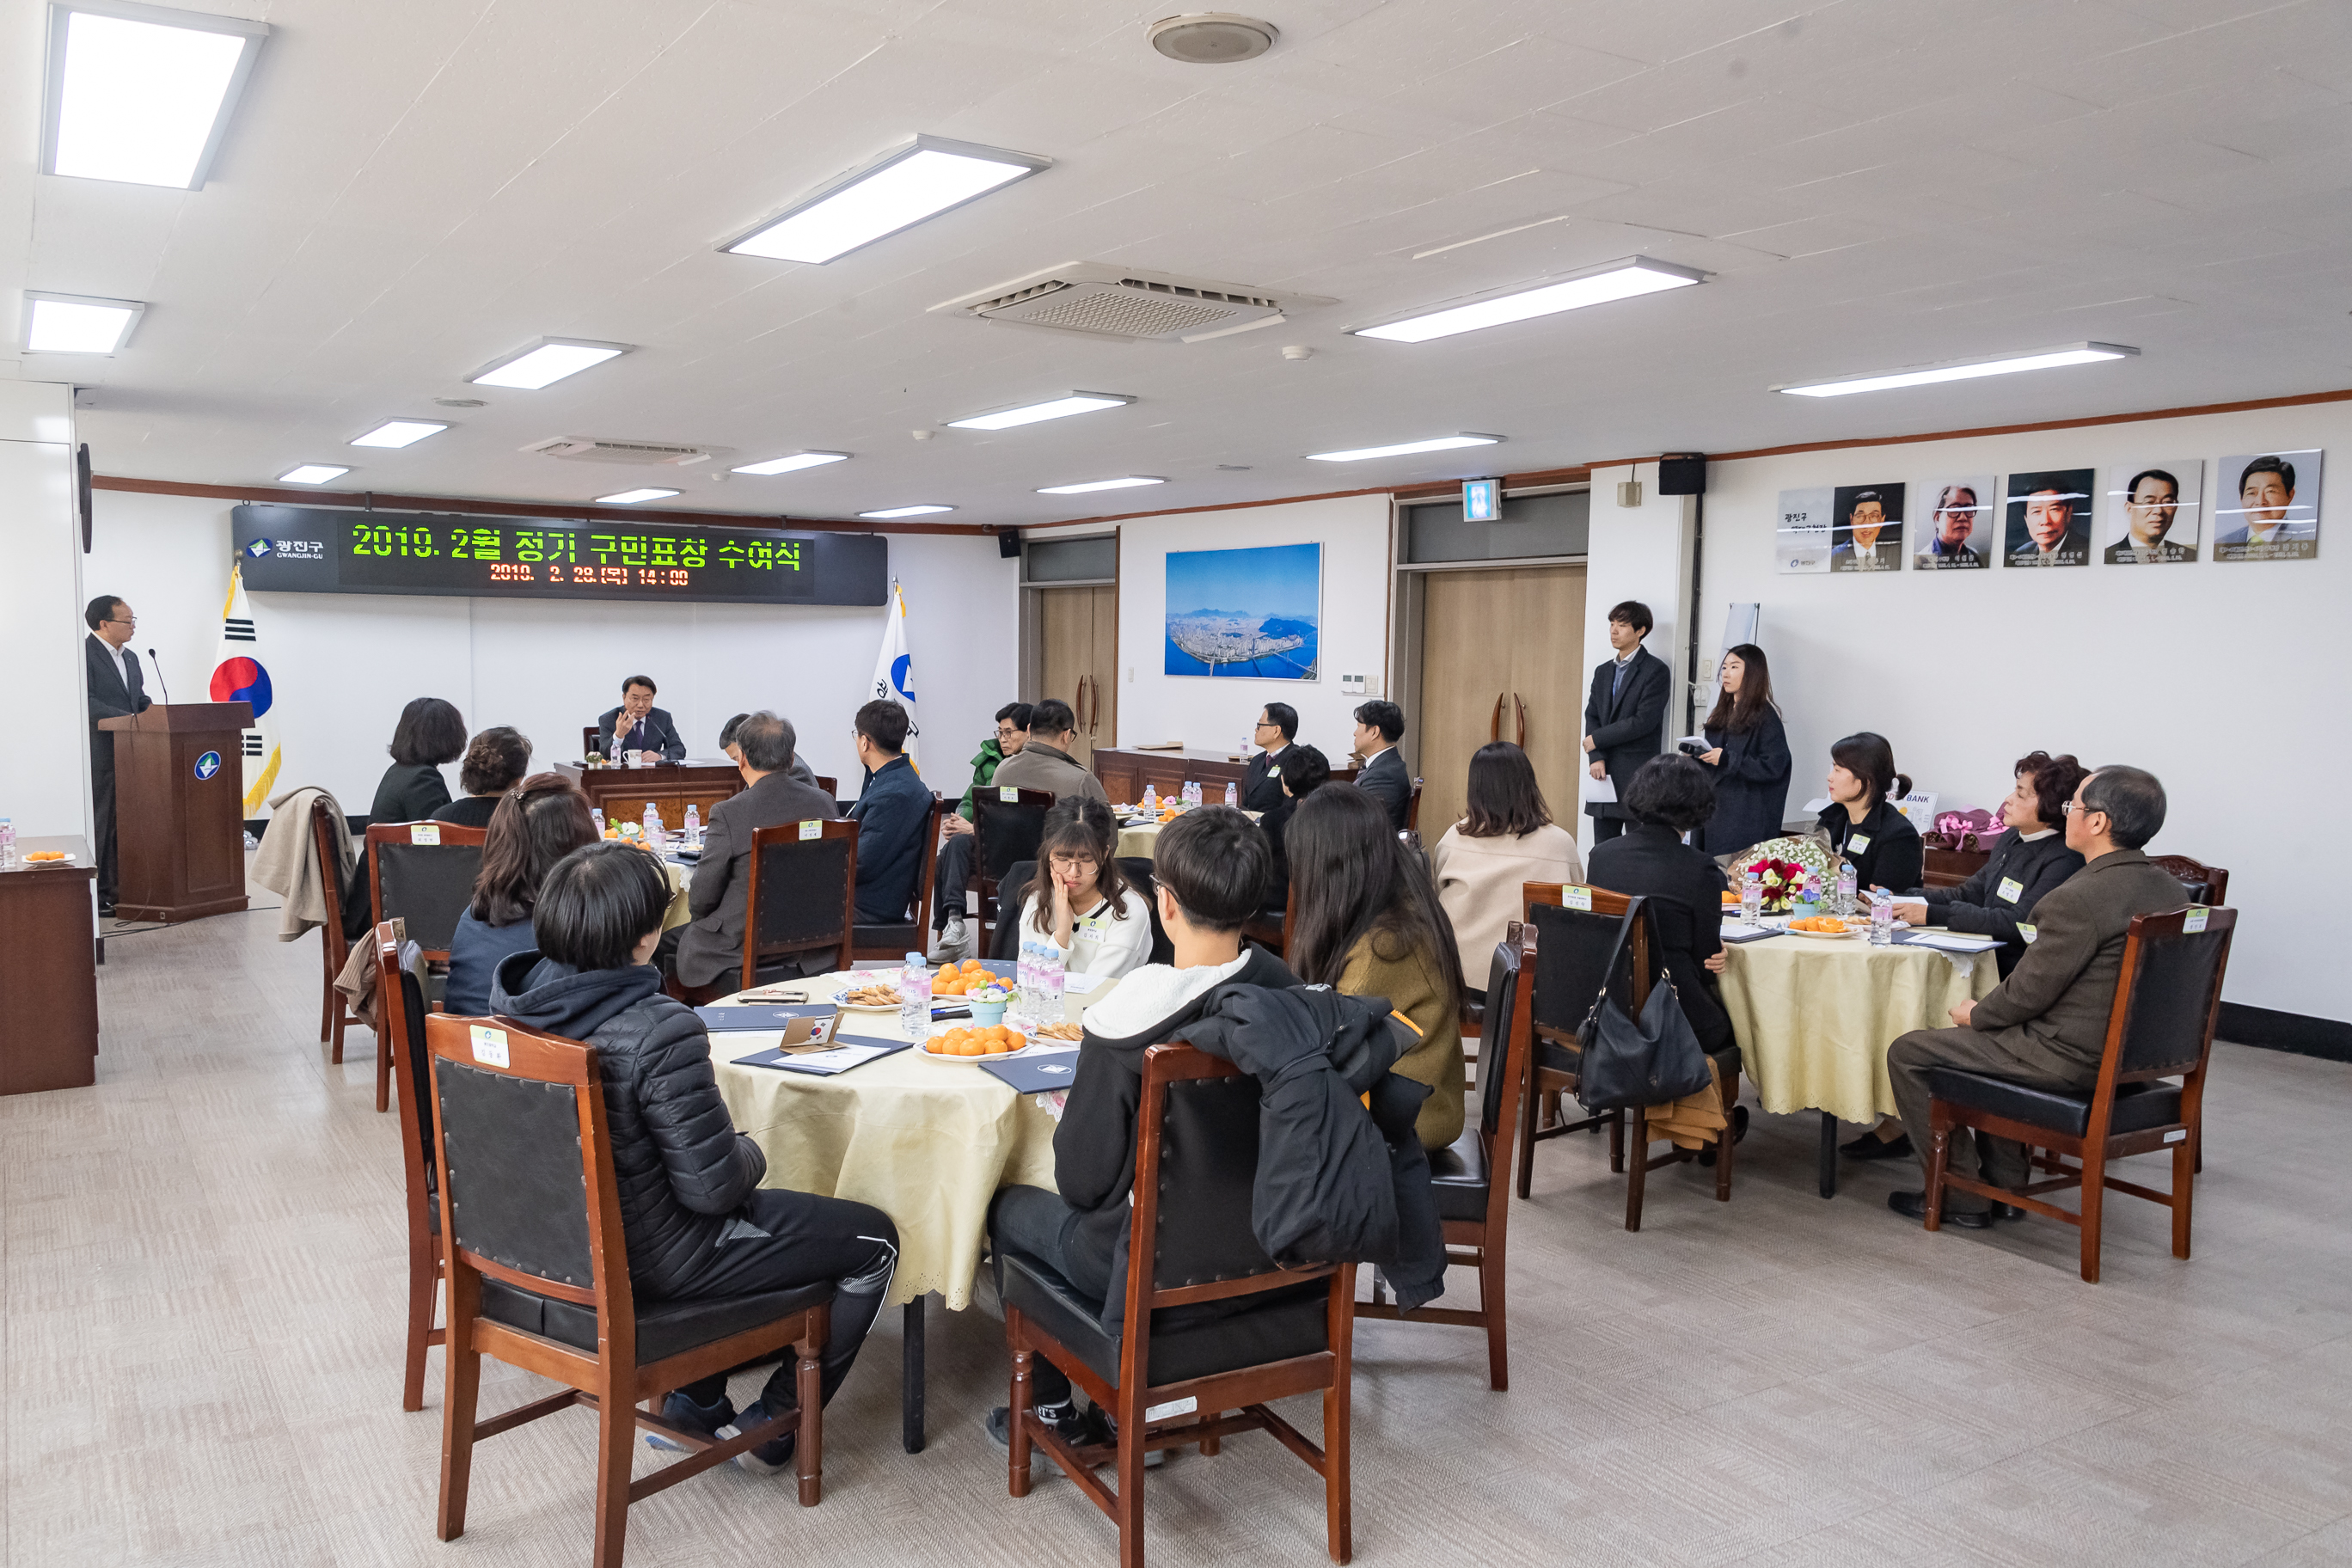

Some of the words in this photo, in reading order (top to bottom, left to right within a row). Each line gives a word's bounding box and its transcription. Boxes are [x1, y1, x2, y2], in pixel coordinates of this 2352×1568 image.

[1785, 512, 1807, 523] 광진구
[276, 540, 324, 553] 광진구
[451, 528, 500, 560] 2월
[515, 530, 576, 563] 정기
[590, 535, 708, 568] 구민표창
[719, 540, 800, 571] 수여식
[549, 565, 565, 582] 2.
[1906, 794, 1930, 804] BANK
